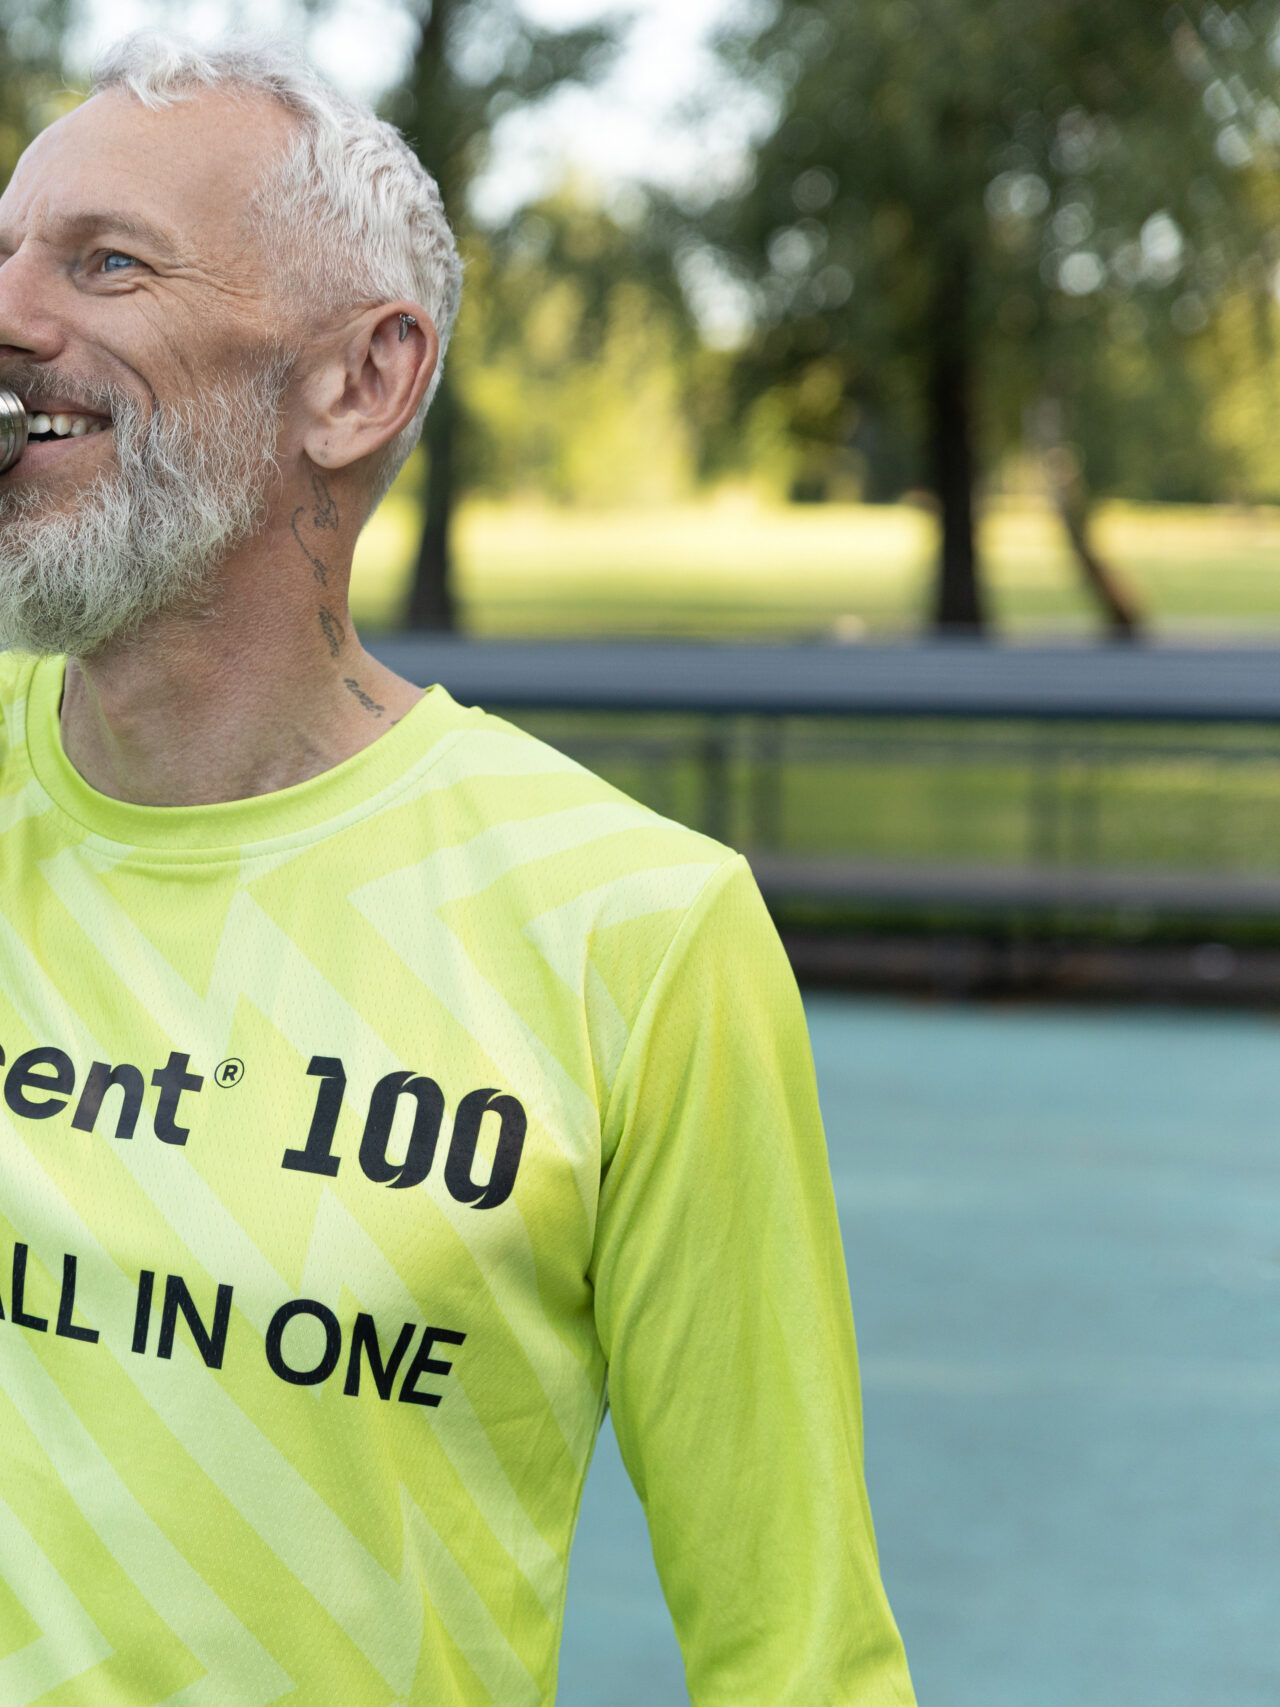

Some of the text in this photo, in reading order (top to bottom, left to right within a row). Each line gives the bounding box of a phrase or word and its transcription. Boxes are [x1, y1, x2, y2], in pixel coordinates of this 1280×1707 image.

[281, 1055, 528, 1210] 100
[131, 1269, 234, 1371] IN
[265, 1299, 467, 1408] ONE
